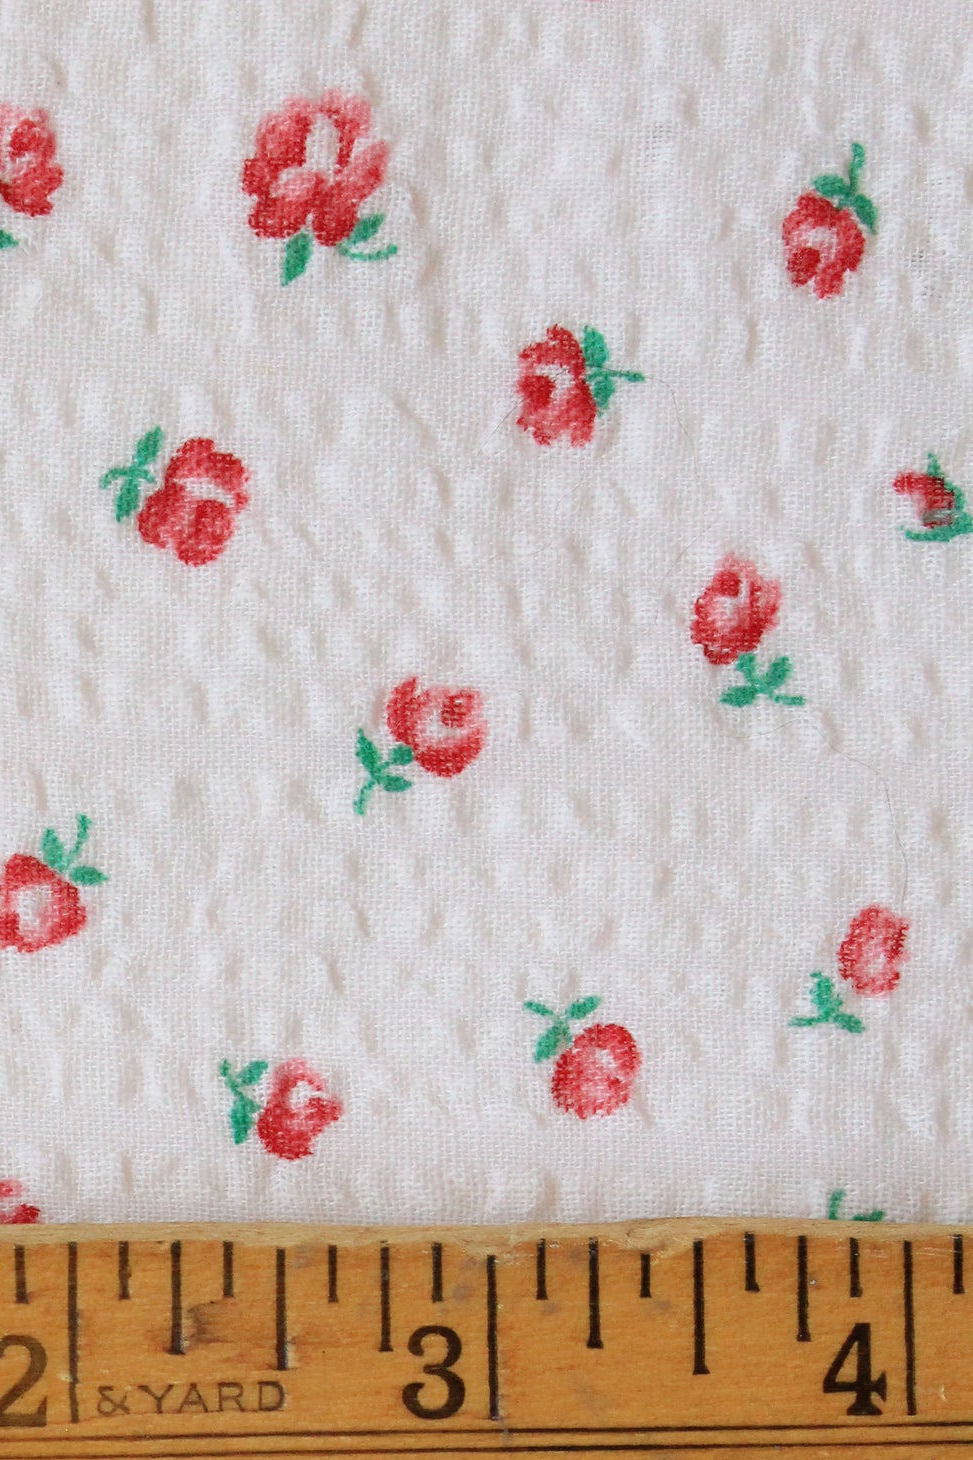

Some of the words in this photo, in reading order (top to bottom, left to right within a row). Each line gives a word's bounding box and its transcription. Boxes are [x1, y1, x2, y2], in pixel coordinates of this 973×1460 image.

[97, 1384, 131, 1415] &
[140, 1381, 287, 1413] YARD
[402, 1325, 466, 1421] 3
[823, 1322, 888, 1416] 4
